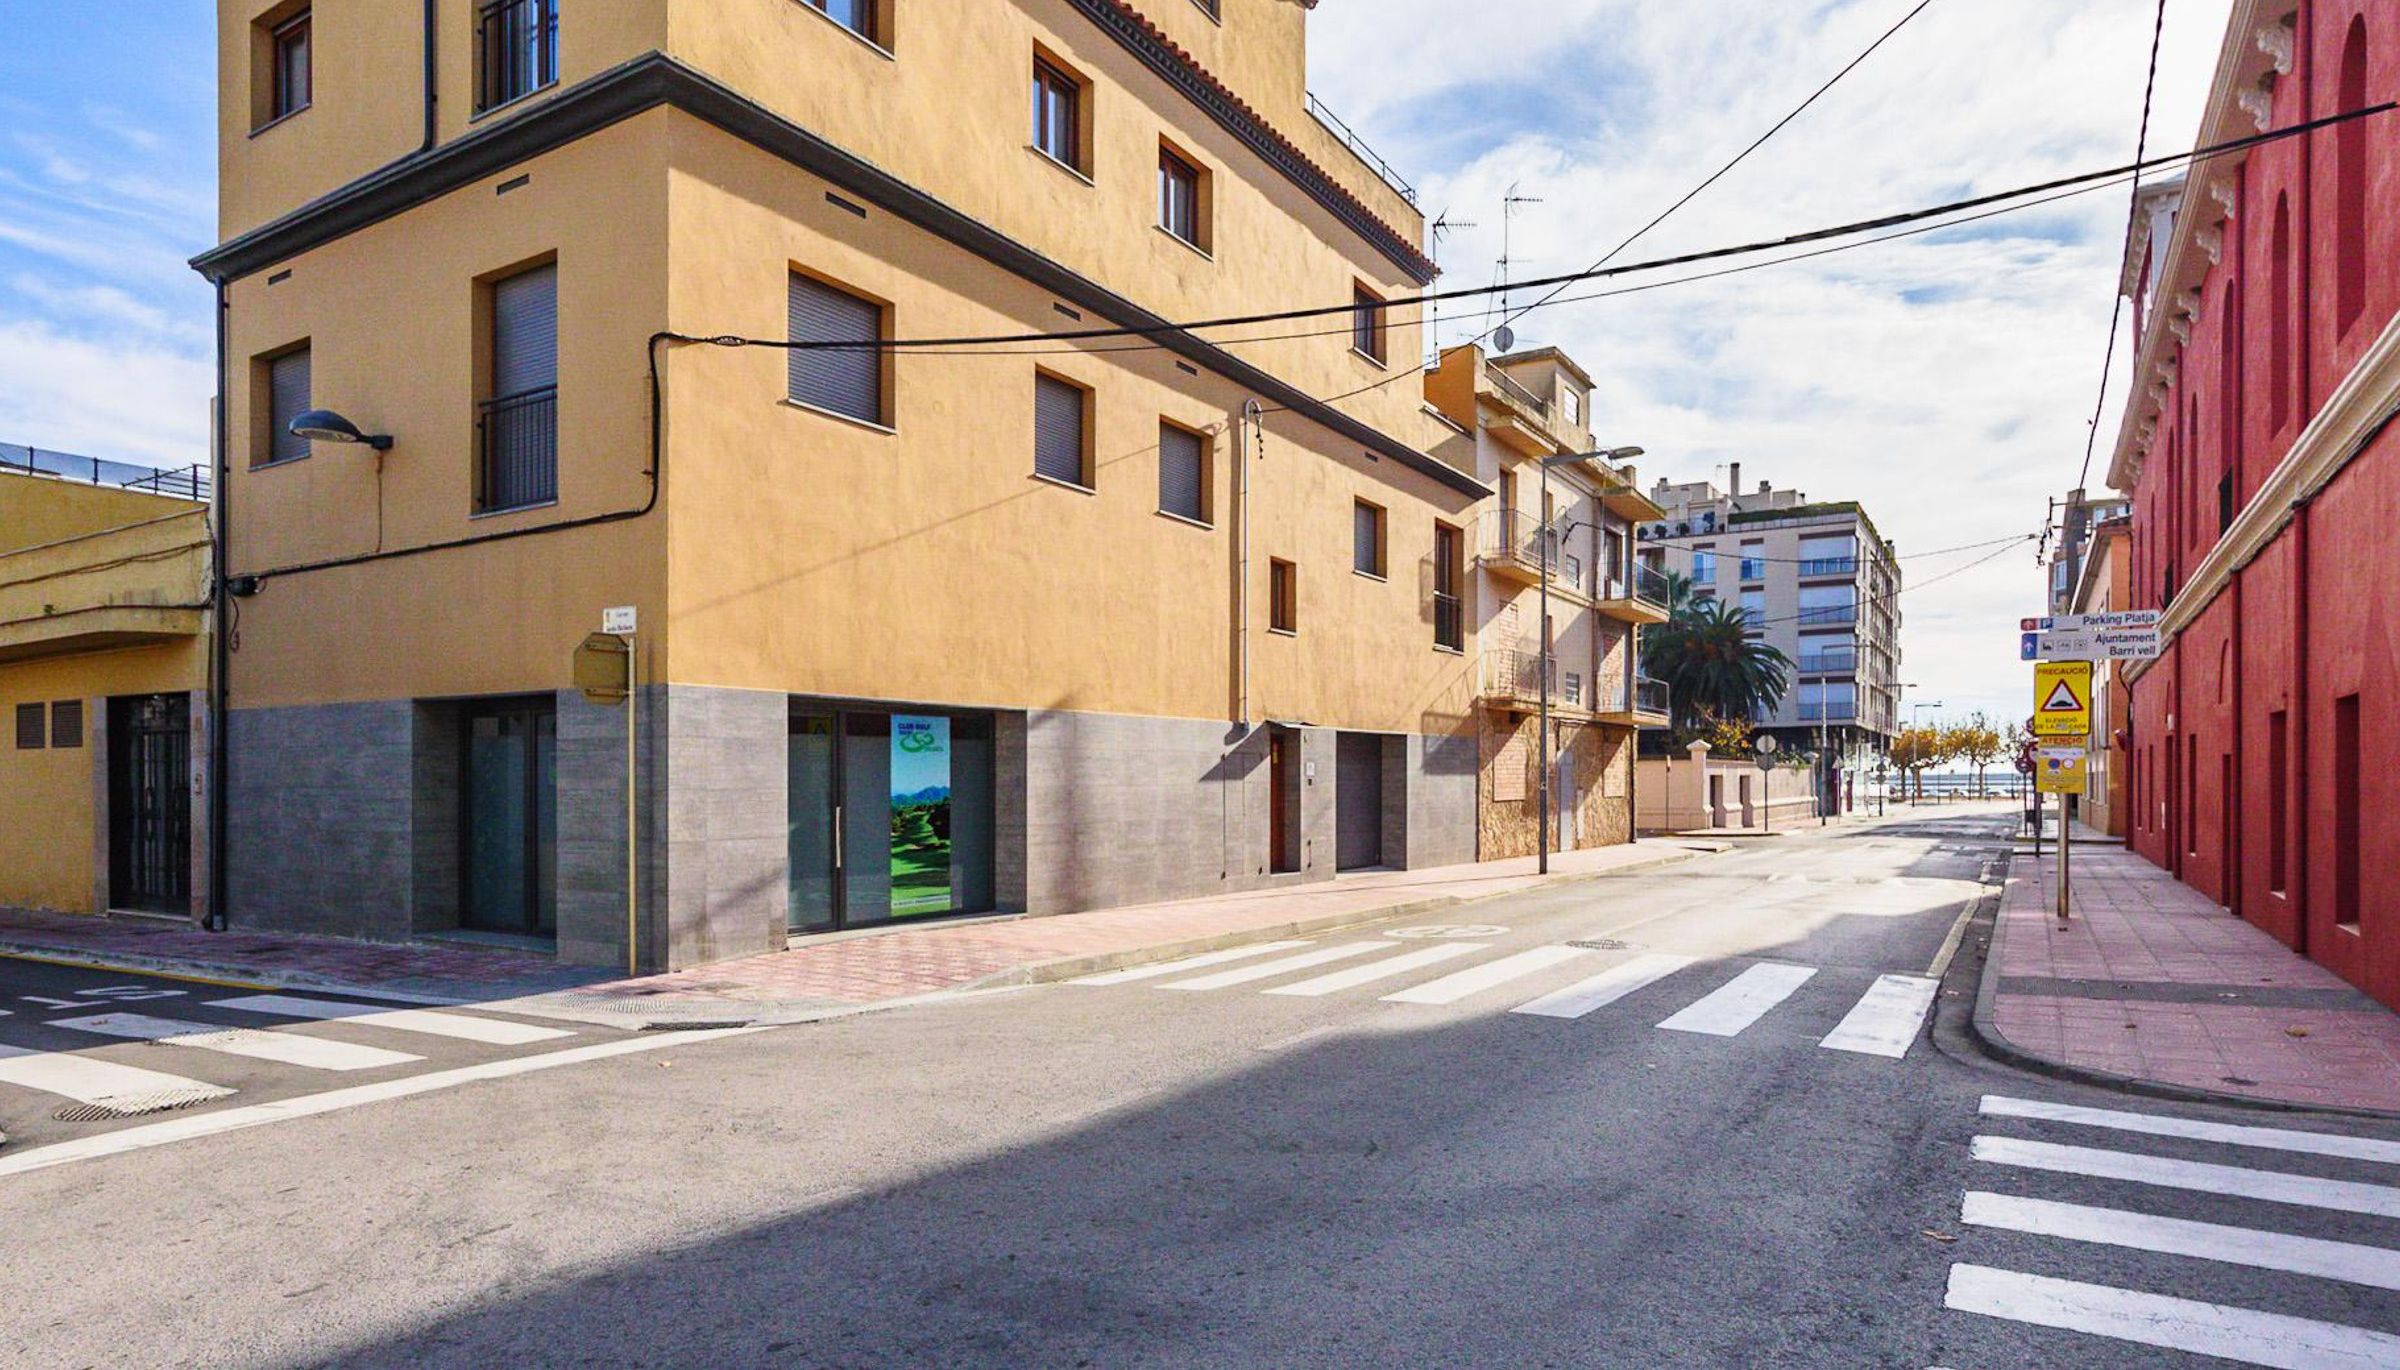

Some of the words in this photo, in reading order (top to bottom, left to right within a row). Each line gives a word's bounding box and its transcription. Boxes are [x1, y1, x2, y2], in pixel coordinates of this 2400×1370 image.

[2083, 614, 2122, 626] Parking
[2125, 613, 2155, 624] Platja
[2095, 633, 2156, 645] Ajuntament
[2109, 646, 2135, 656] Barri
[2137, 645, 2156, 655] vell
[2037, 666, 2088, 675] PRECAUCIÓ
[2042, 736, 2083, 744] ATENCIÓ
